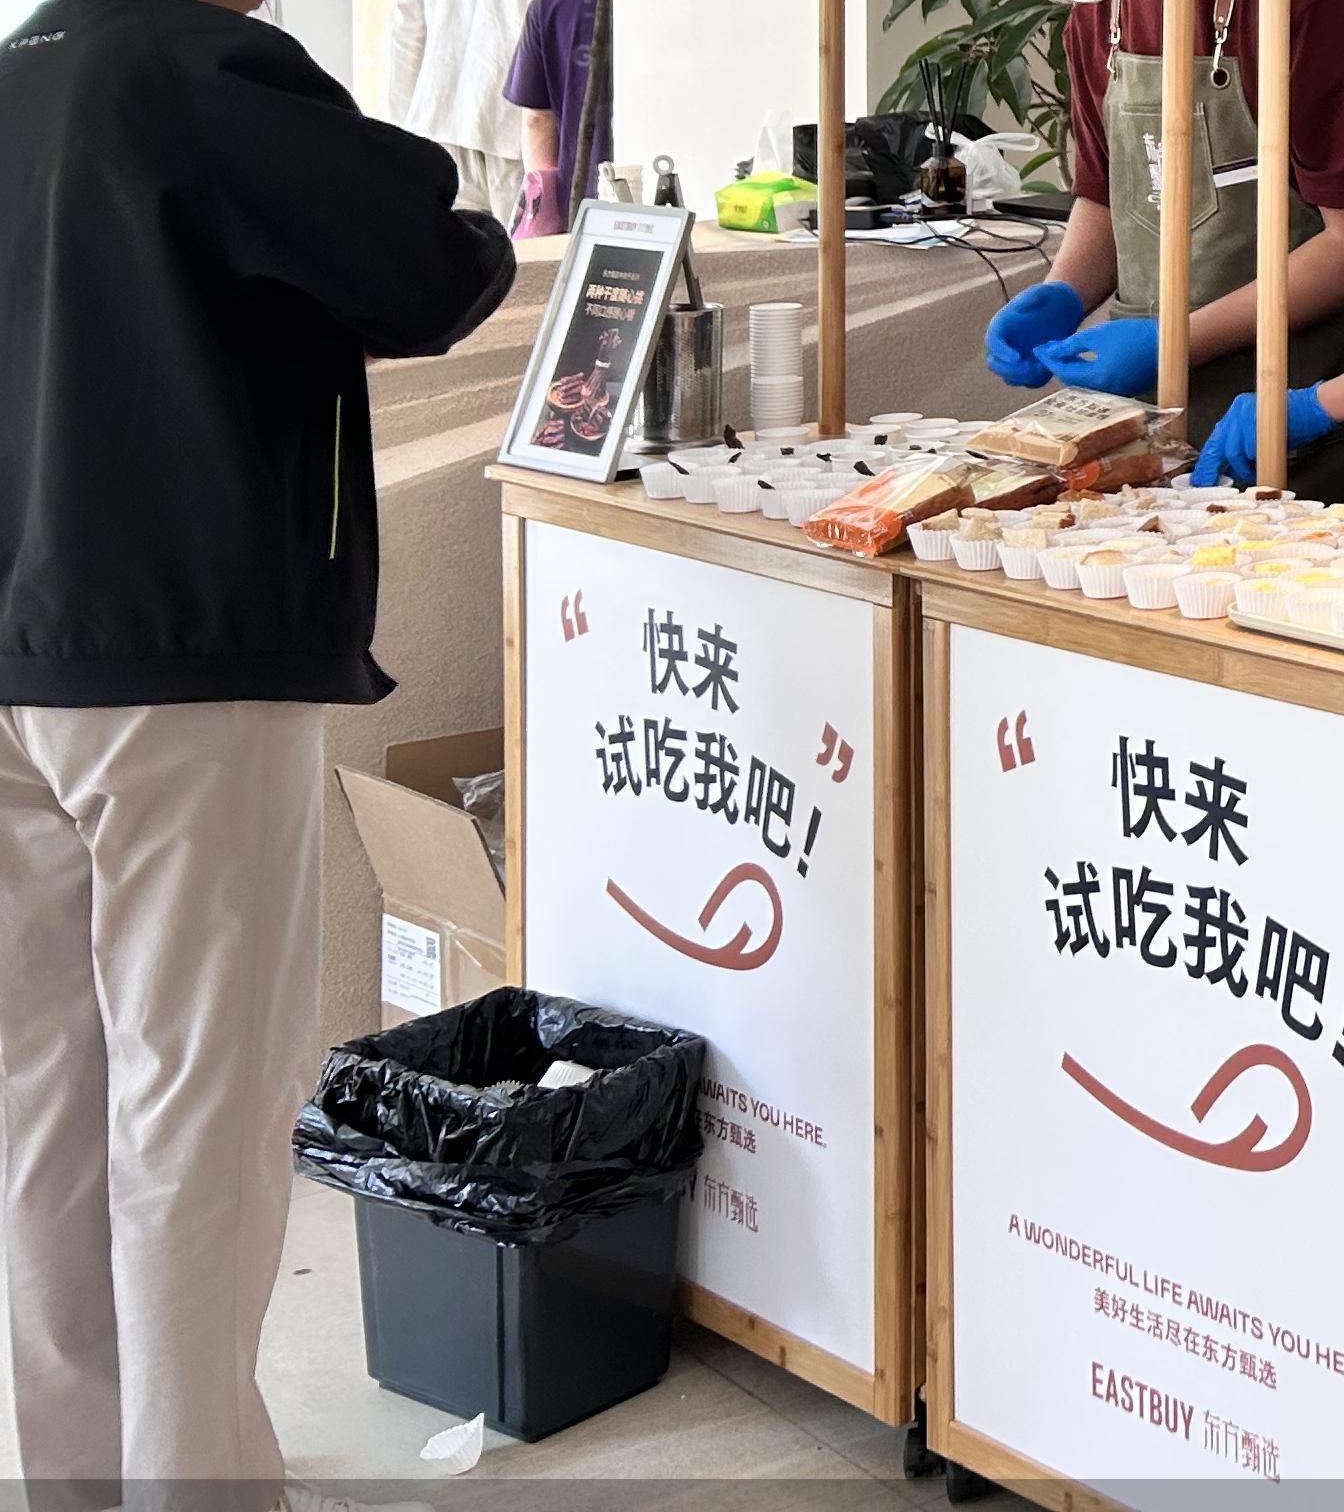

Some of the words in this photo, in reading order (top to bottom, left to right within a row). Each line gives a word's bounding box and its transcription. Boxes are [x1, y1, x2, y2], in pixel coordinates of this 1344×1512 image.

[643, 608, 740, 714] 快来
[595, 714, 823, 880] 试吃我吧！
[1112, 736, 1249, 867] 快来
[750, 1097, 781, 1127] YOU
[783, 1111, 827, 1149] HERE.
[1008, 1214, 1021, 1237] A
[1024, 1218, 1139, 1289] WONDERFUL
[1143, 1269, 1183, 1306] LIFE
[1186, 1290, 1263, 1341] AWAITS
[1268, 1322, 1310, 1360] YOU
[1094, 1286, 1278, 1390] 美好生活尽在东方甄选
[1092, 1361, 1194, 1440] EASTBUY
[1202, 1410, 1281, 1484] 东方甄选
